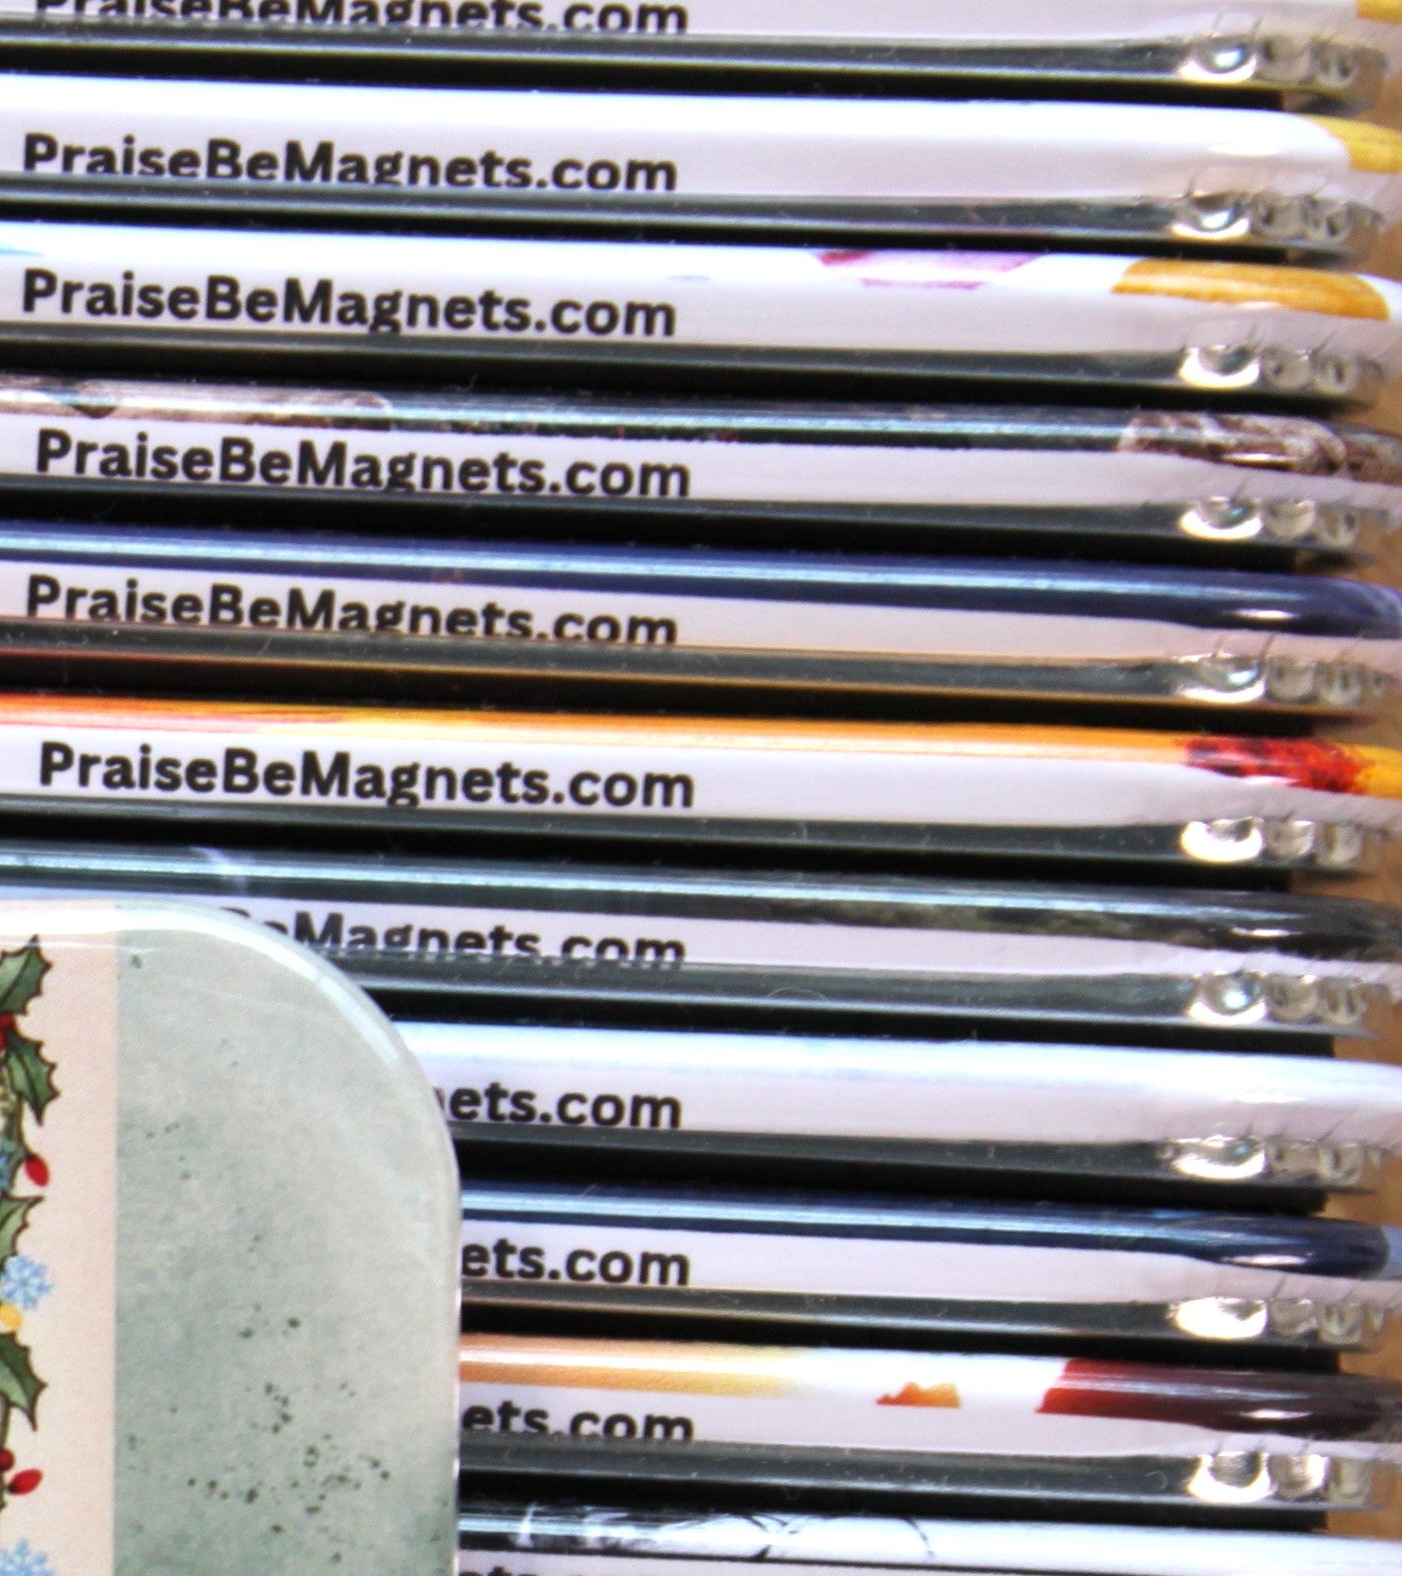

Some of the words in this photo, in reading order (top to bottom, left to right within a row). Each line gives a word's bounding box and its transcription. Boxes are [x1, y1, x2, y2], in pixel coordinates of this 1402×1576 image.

[24, 132, 677, 192] PraiseBeMagnets.com
[23, 268, 675, 336] PraiseBeMagnets.com
[37, 427, 690, 497] PraiseBeMagnets.com
[27, 574, 678, 645] PraiseBeMagnets.com
[39, 741, 694, 808] PraiseBeMagnets.com
